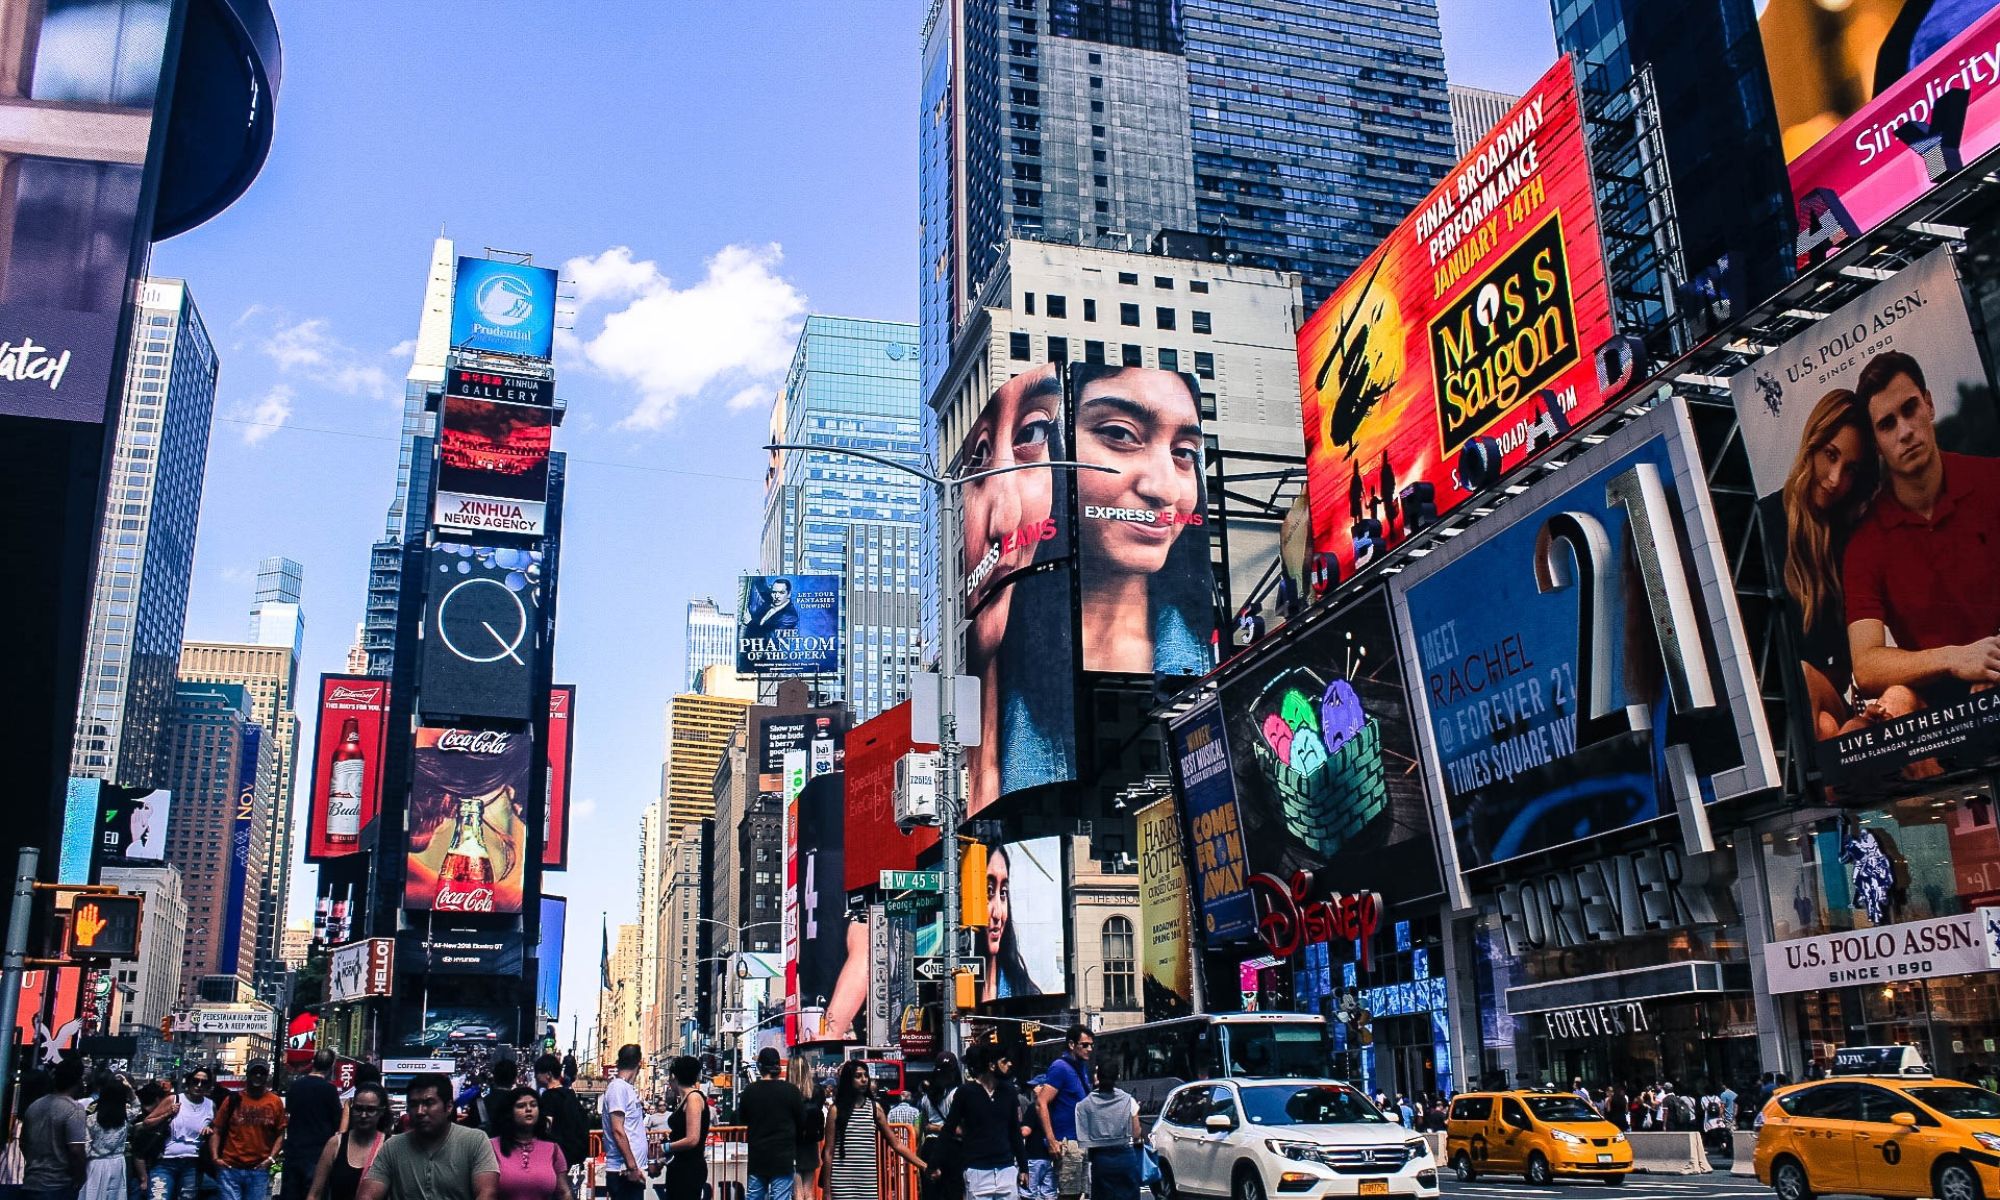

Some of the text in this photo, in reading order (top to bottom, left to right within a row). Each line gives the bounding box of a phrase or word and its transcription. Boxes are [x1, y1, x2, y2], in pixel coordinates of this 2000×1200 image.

[1415, 94, 1544, 245] FINAL BROADWAY
[1429, 141, 1538, 266] PERFORMANCE
[1434, 175, 1546, 299] JANUARY 14TH
[474, 323, 531, 341] Prudential
[1787, 289, 1928, 383] U.S. POLO ASSN.
[0, 337, 71, 390] atch
[1445, 305, 1569, 429] Saigon
[1818, 335, 1893, 384] SINCE 1890
[462, 385, 538, 400] GALLERY
[504, 379, 539, 390] XINHUA
[444, 512, 537, 531] NEWS AGENCY
[460, 501, 523, 519] XINHUA
[1085, 505, 1203, 526] EXPRESS JEANS
[967, 517, 1057, 597] EXPRESS JEANS
[739, 636, 836, 653] PHANTOM
[775, 628, 799, 638] THE
[1421, 619, 1460, 670] MEET
[747, 651, 826, 660] OF THE OPERA
[1430, 632, 1533, 710] RACHEL
[1438, 662, 1576, 753] @ FOREVER 21
[438, 728, 511, 754] Coca-Cola
[769, 748, 785, 757] good
[816, 744, 829, 753] bai
[1839, 733, 1874, 753] LIVE
[1841, 752, 1866, 765] PAMELA
[1868, 740, 1907, 758] FLANAGAN
[1917, 730, 1943, 744] JONNY
[1945, 720, 1974, 736] LAVINE
[1908, 735, 1967, 756] USPOLOASSN.COM
[1180, 738, 1224, 778] BEST MUSICAL
[1448, 749, 1492, 796] TIMES
[1491, 725, 1552, 783] SQUARE
[329, 801, 360, 816] Bud
[1192, 801, 1238, 843] COME
[1144, 815, 1179, 851] HARRY
[1143, 843, 1181, 884] POTTER
[895, 873, 906, 888] W
[912, 874, 926, 888] 45
[1148, 877, 1182, 898] CURSED CHILD
[1203, 860, 1244, 902] AWAY
[435, 886, 494, 911] Coca-Cola
[1493, 844, 1715, 957] FOREVER
[1153, 920, 1180, 933] BROADWAY
[1247, 869, 1384, 976] Disney
[1153, 933, 1170, 945] SPRING
[1785, 921, 1980, 969] U.S. POLO ASSN.
[374, 941, 389, 993] HELLO!
[924, 965, 944, 974] ONE
[1829, 960, 1933, 983] SINCE 1890
[203, 1013, 236, 1021] PEDESTRIAN
[1545, 1001, 1649, 1040] FOREVER 21
